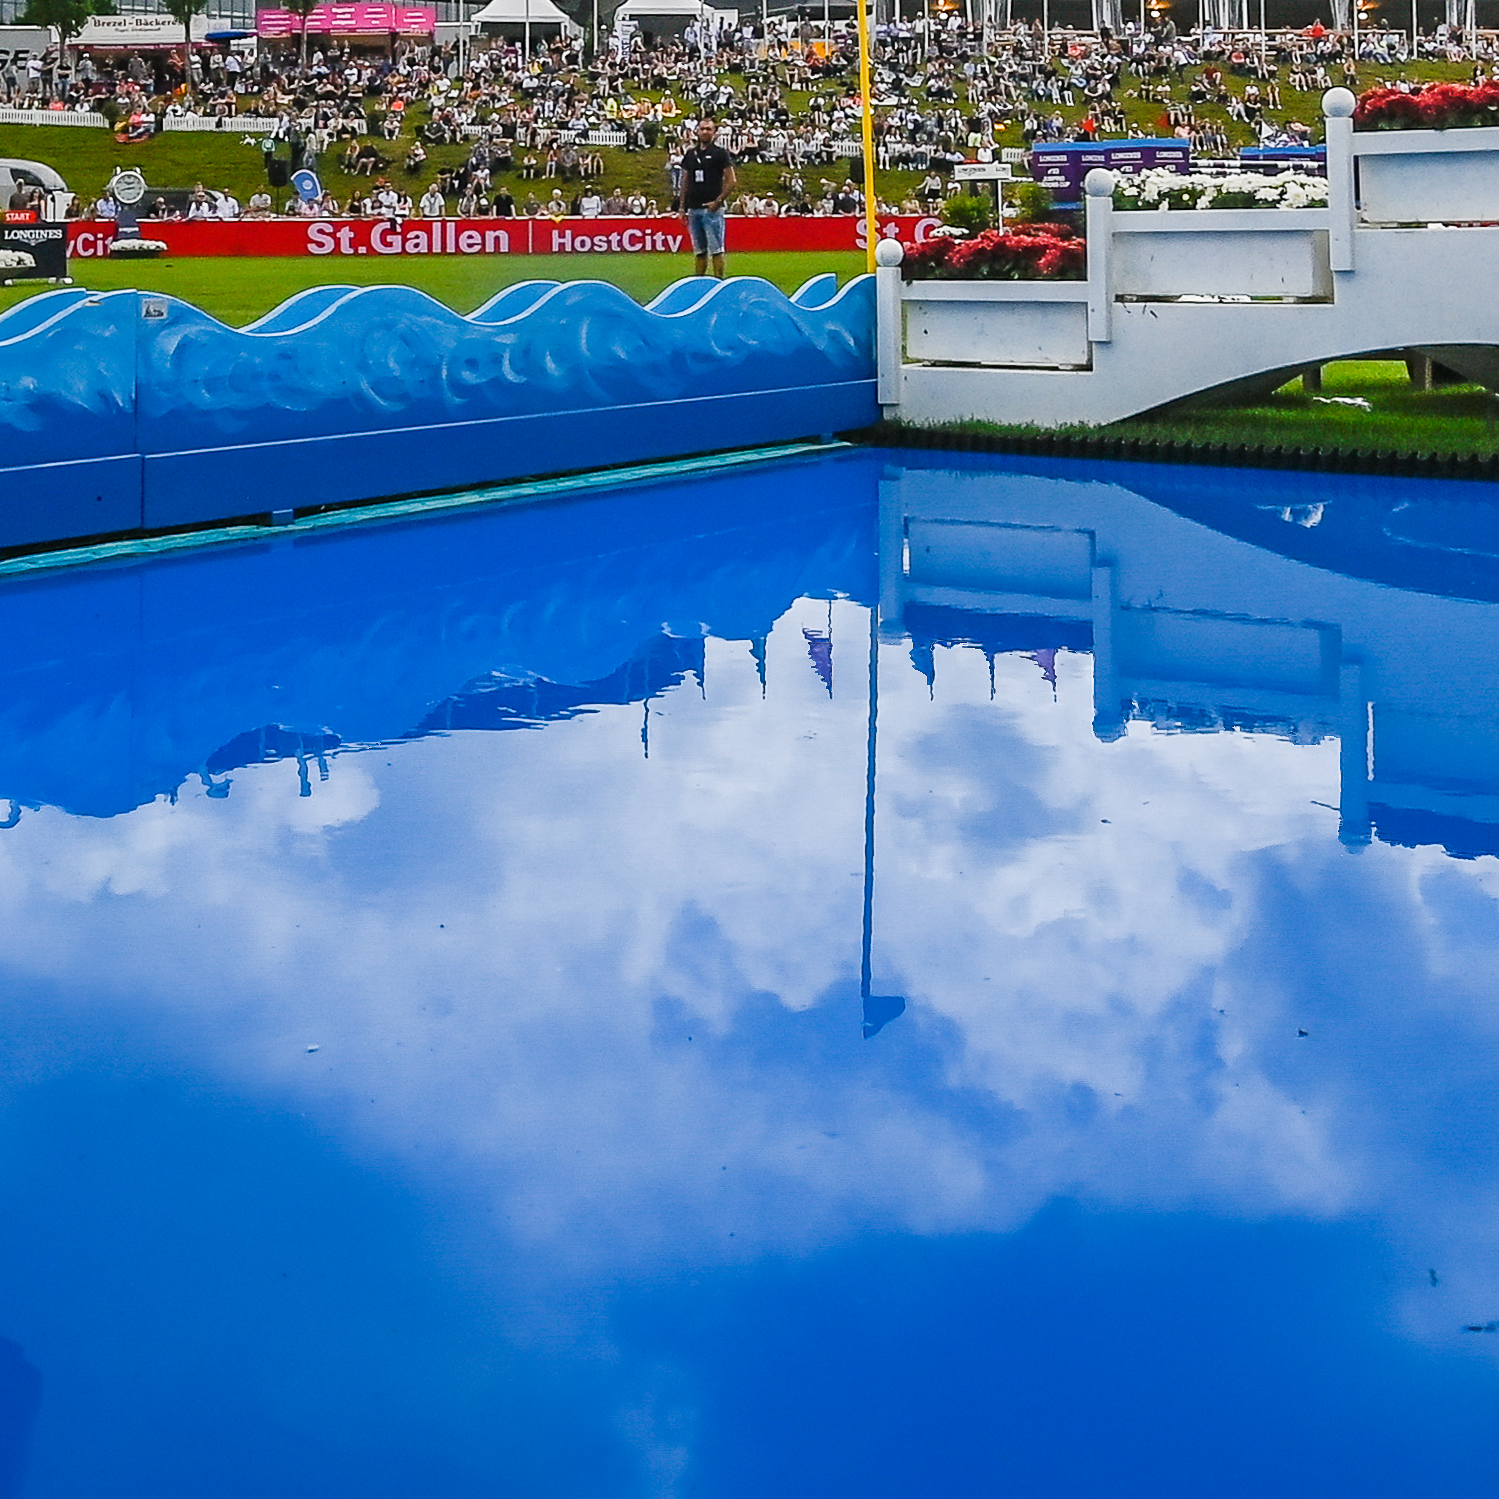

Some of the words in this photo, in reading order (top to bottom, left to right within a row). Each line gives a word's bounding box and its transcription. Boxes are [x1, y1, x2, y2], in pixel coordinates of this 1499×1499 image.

[5, 212, 31, 221] START
[4, 229, 63, 240] LONGINES
[306, 222, 509, 254] St.Gallen
[551, 229, 683, 253] HostCity
